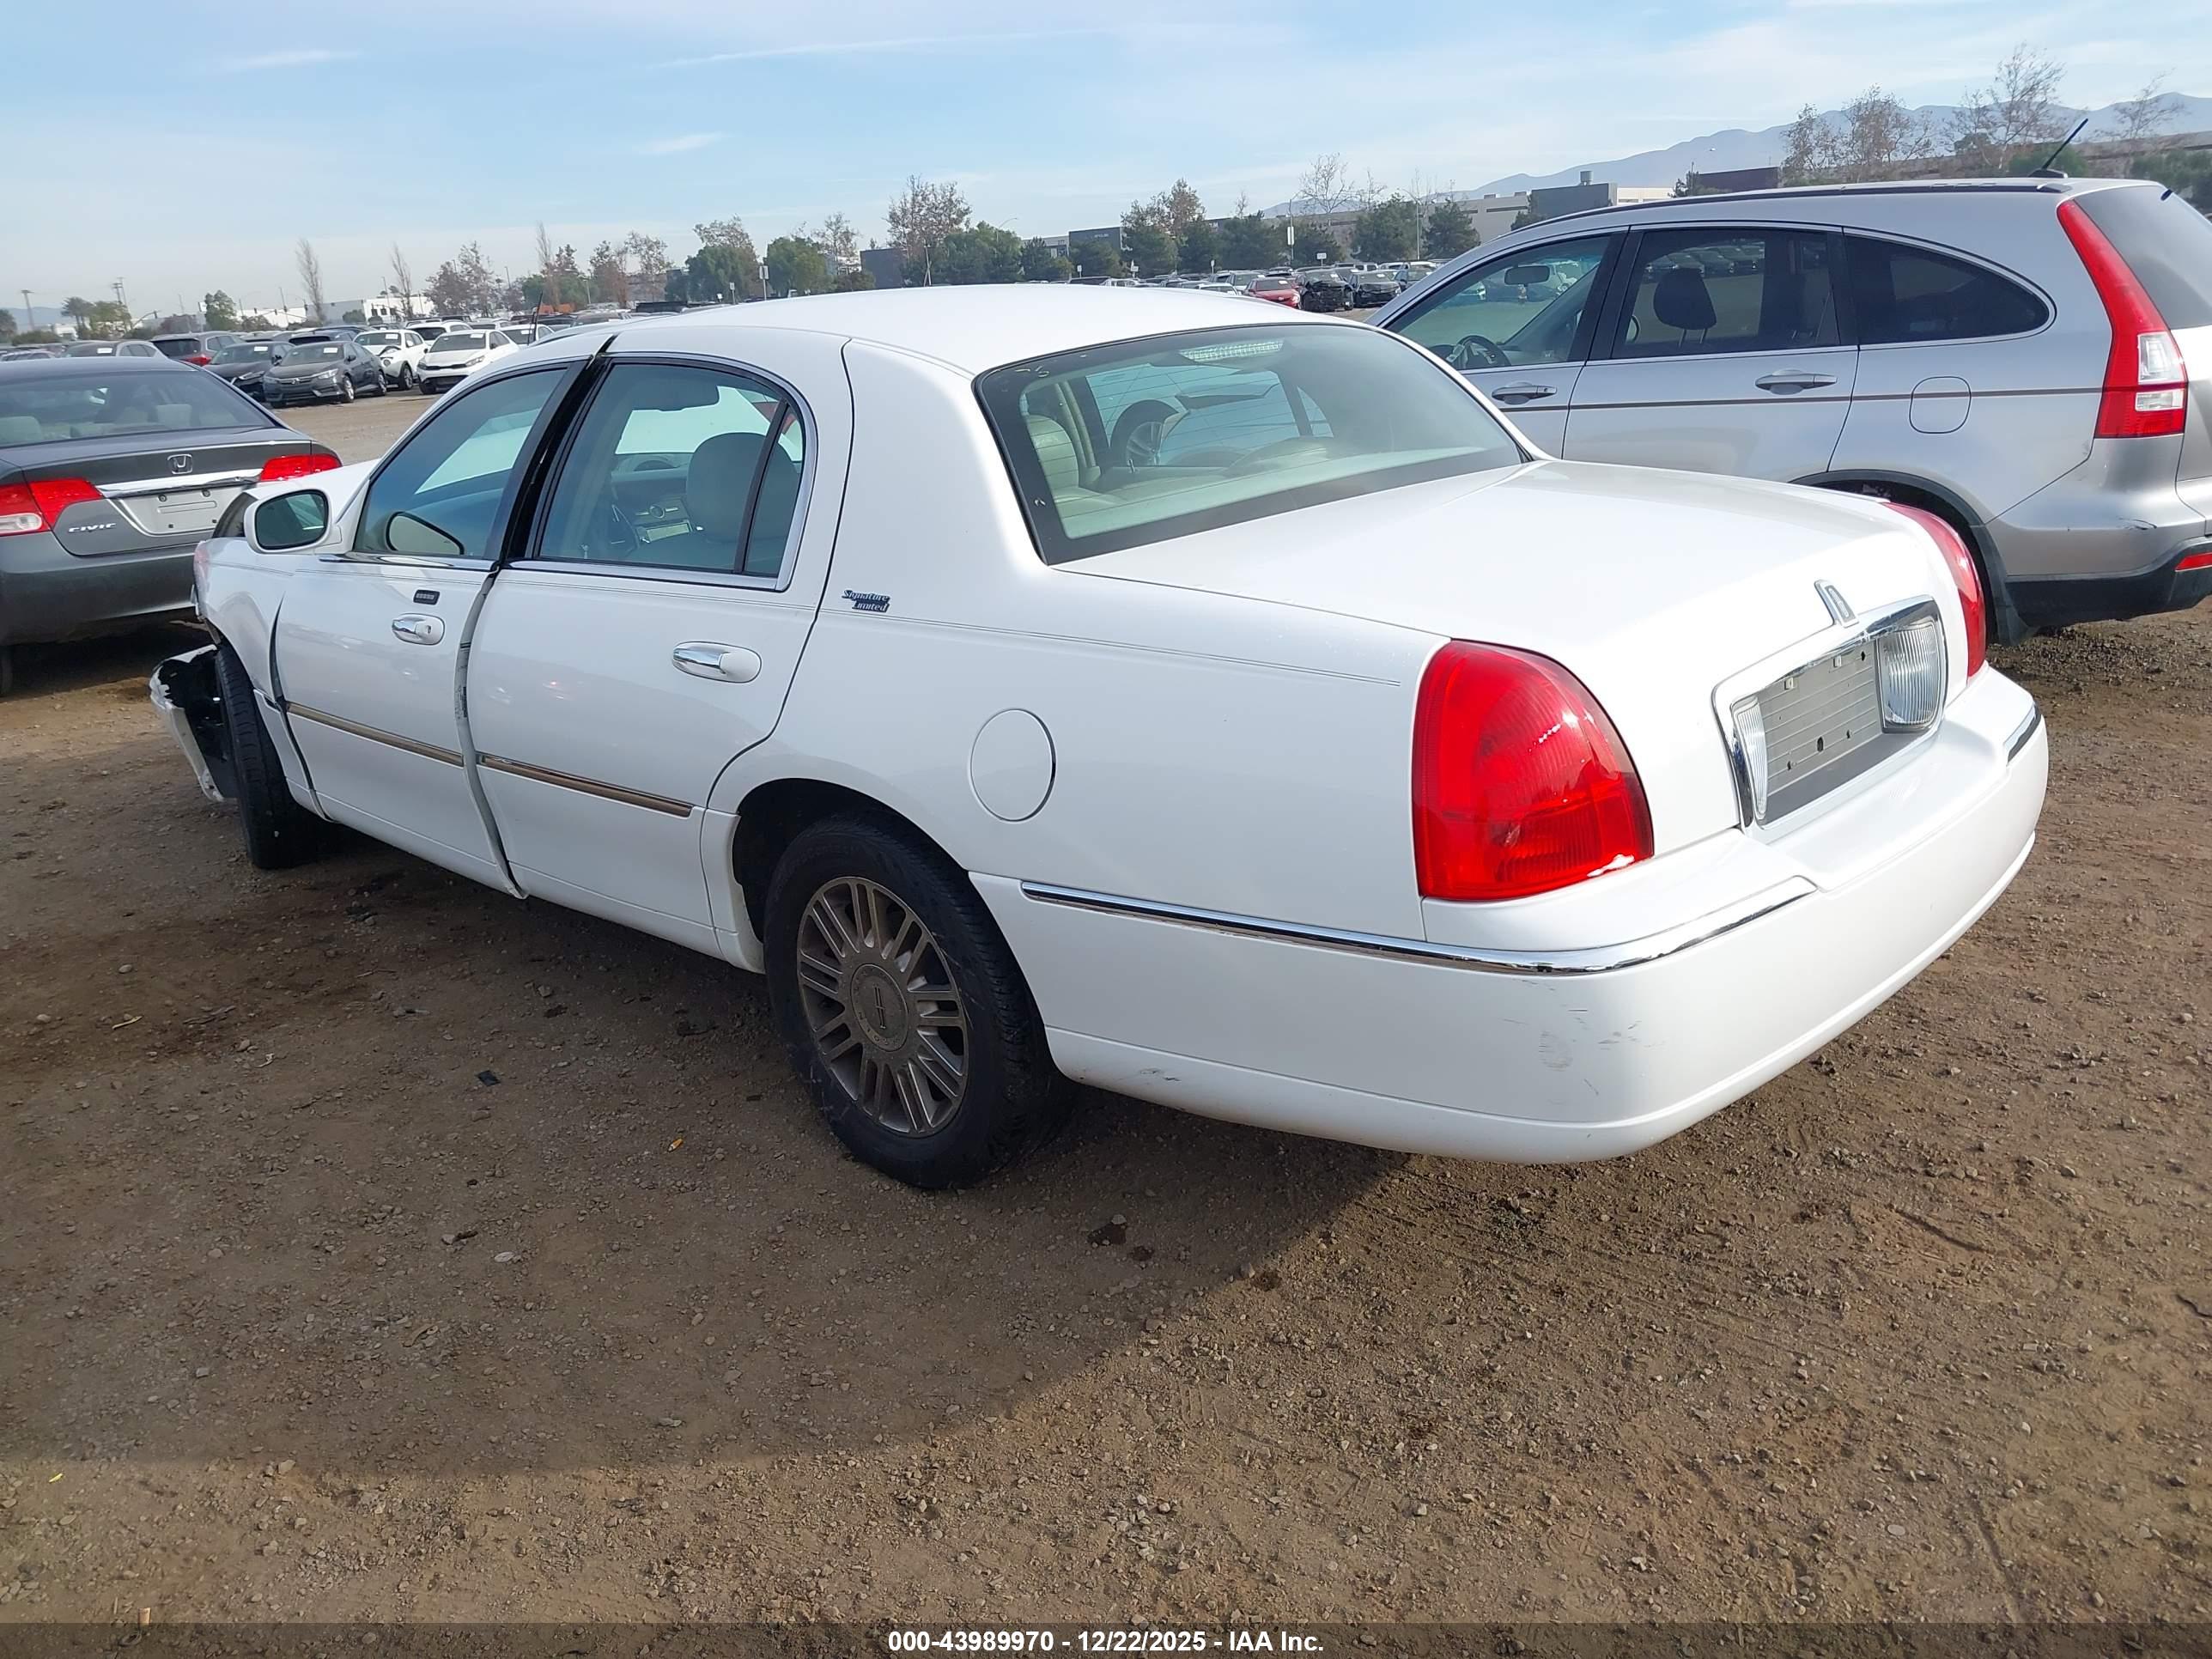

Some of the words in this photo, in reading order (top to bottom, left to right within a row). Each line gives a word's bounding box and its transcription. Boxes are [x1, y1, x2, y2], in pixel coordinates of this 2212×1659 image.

[69, 522, 117, 532] CIVIC
[842, 589, 890, 602] Signature
[852, 601, 890, 613] Limited
